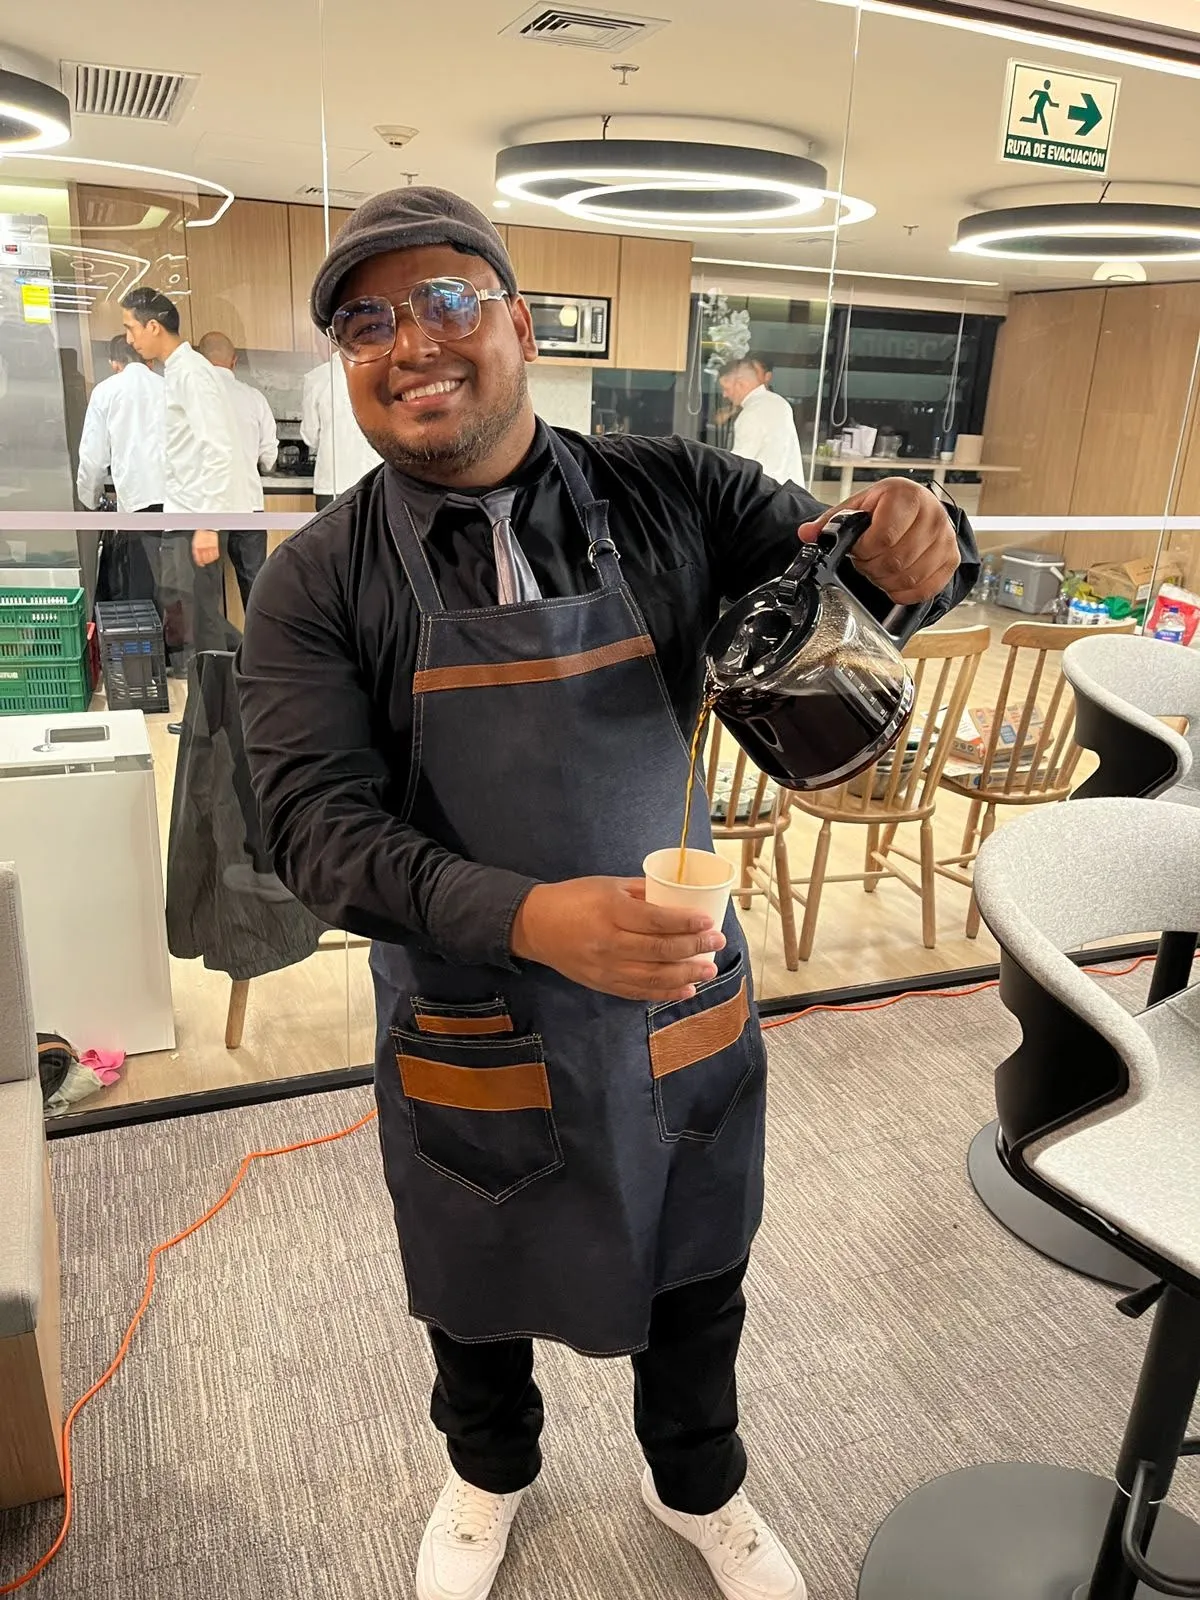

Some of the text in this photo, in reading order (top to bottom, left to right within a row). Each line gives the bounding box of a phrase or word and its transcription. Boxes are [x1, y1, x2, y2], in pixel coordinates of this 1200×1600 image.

[1006, 139, 1105, 168] RUTA DE EVACUACIÓN
